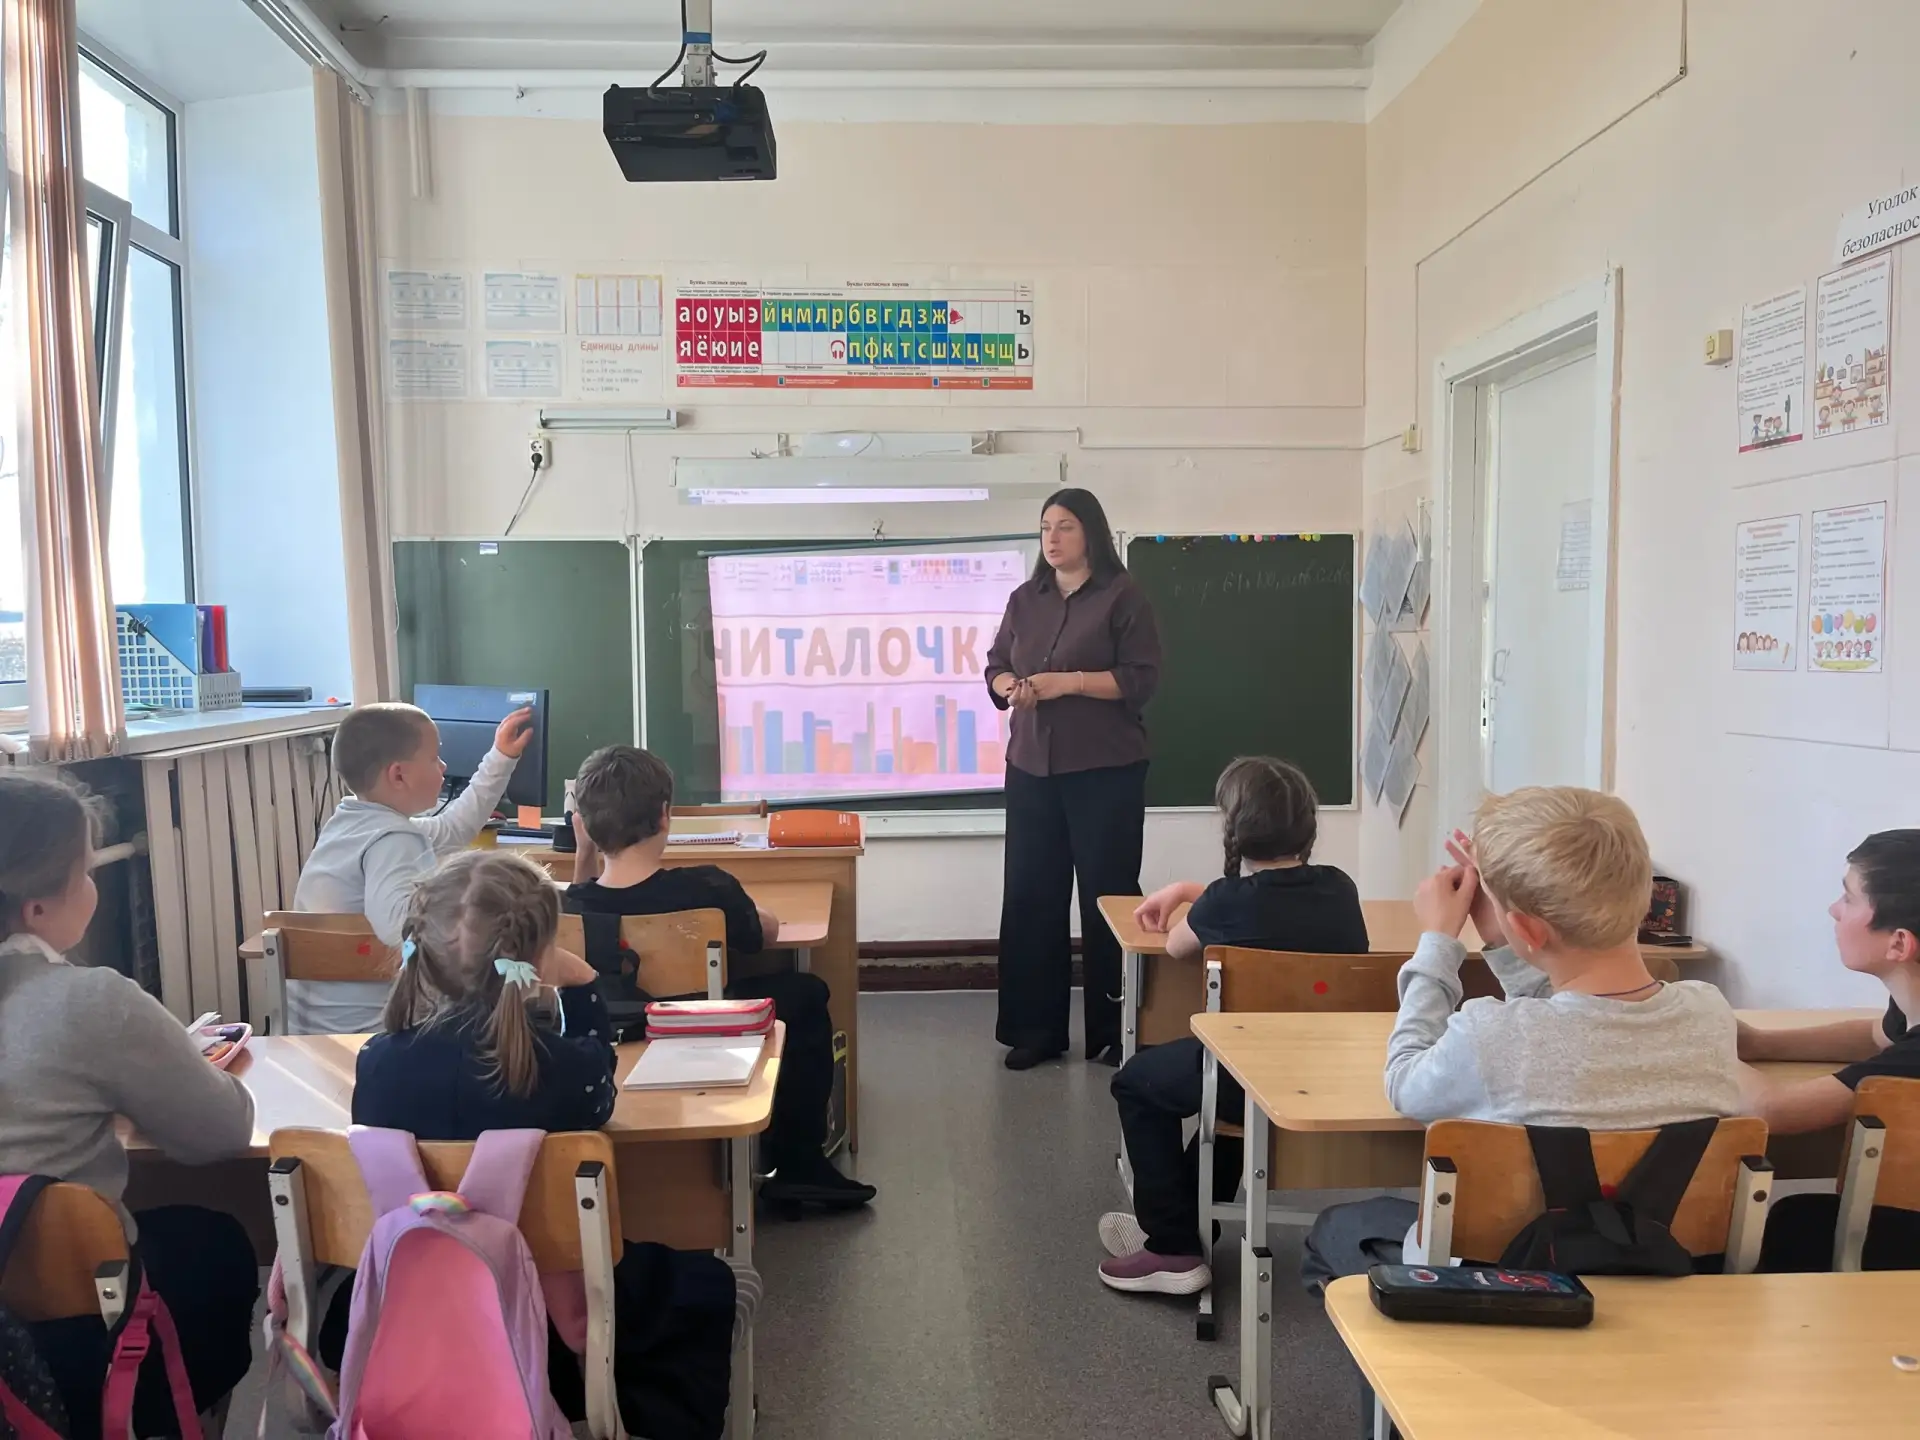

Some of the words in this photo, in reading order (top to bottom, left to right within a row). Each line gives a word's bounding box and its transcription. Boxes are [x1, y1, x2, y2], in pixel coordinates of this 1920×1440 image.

[1867, 186, 1918, 219] Уголок
[580, 341, 624, 354] Единицы
[628, 342, 659, 354] длины
[703, 625, 1000, 677] ЧИТАЛОЧК
